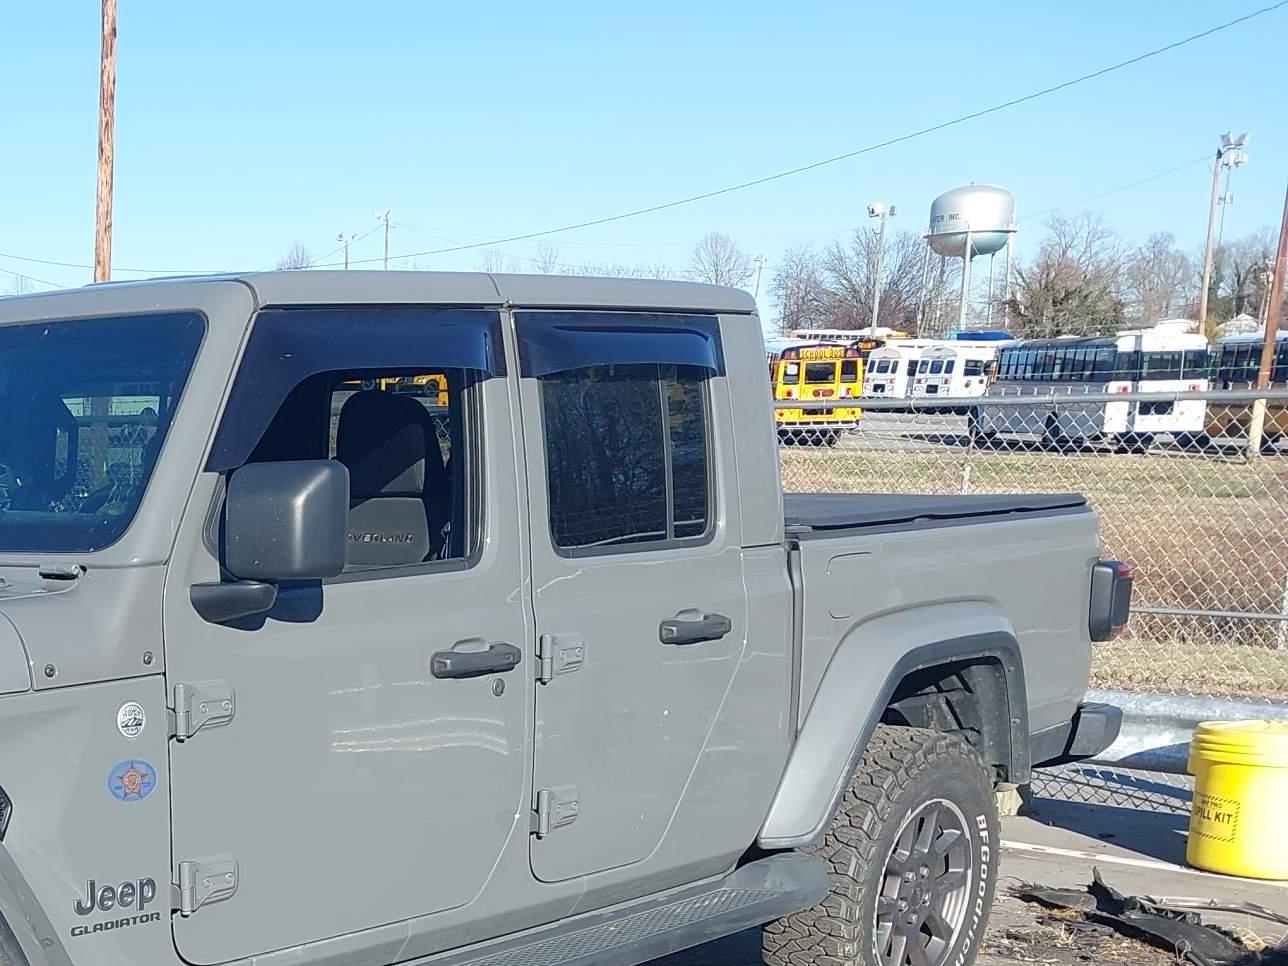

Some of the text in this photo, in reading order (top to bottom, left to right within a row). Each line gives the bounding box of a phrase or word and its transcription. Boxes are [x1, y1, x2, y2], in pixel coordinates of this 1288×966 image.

[801, 347, 845, 361] SCHOOL BUS
[1214, 811, 1233, 825] KIT
[73, 877, 157, 916] Jeep
[70, 911, 161, 937] GLADIATOR
